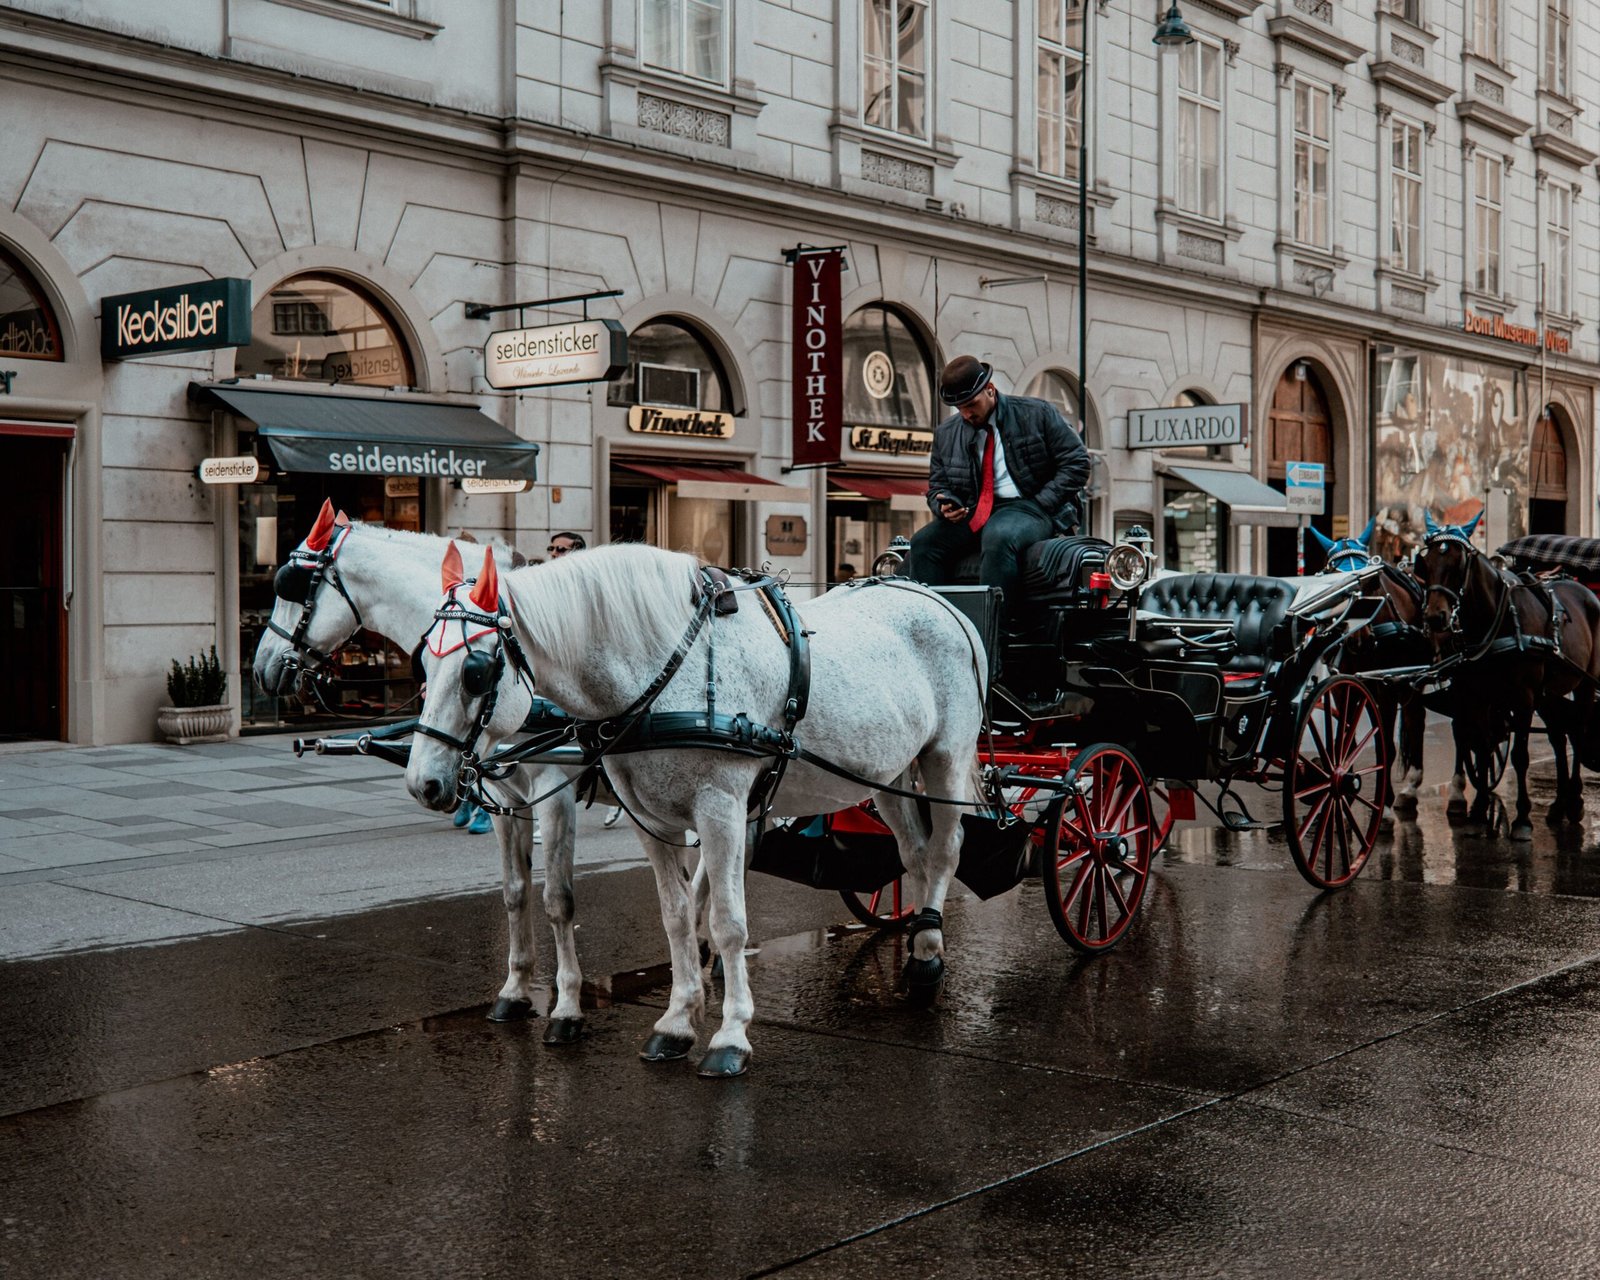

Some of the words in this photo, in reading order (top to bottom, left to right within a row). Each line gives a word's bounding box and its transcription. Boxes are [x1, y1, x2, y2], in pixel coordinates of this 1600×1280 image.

[117, 294, 224, 347] Kecksilber
[1464, 309, 1491, 335] Dom
[1493, 313, 1538, 346] Museum
[496, 326, 599, 361] seidensticker
[805, 258, 827, 443] VINOTHEK
[640, 408, 725, 436] Vinothek
[1138, 414, 1235, 443] LUXARDO
[204, 463, 255, 478] seidensticker
[329, 446, 487, 476] seidensticker
